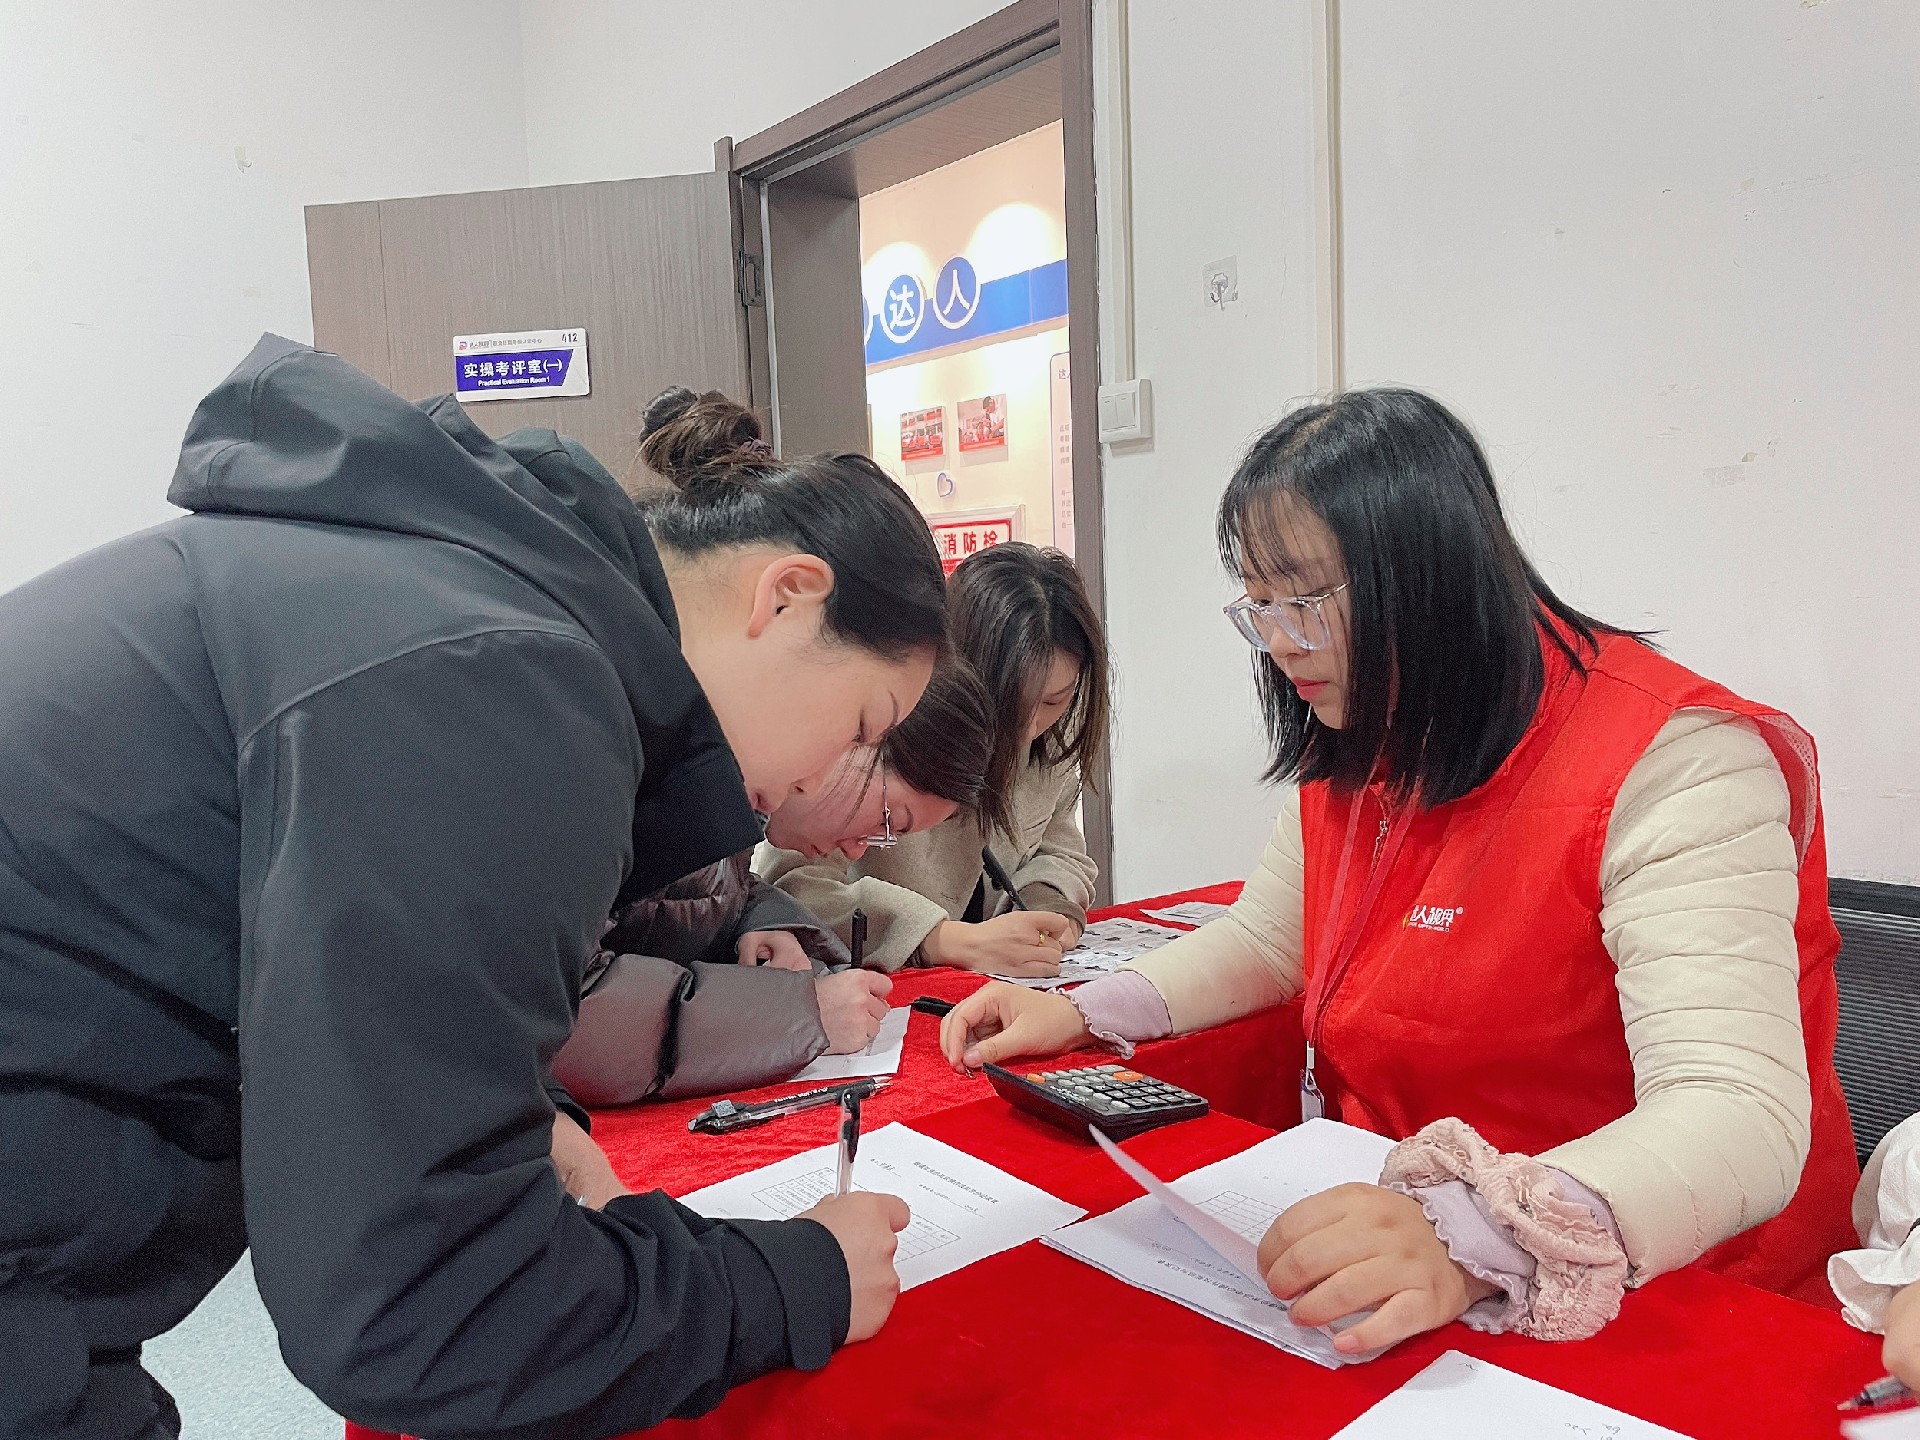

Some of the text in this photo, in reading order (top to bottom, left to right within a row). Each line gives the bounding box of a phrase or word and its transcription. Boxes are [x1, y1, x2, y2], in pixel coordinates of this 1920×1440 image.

[561, 333, 578, 343] 412
[478, 379, 501, 387] Practical
[502, 377, 530, 386] Evaluation
[530, 376, 546, 384] Room
